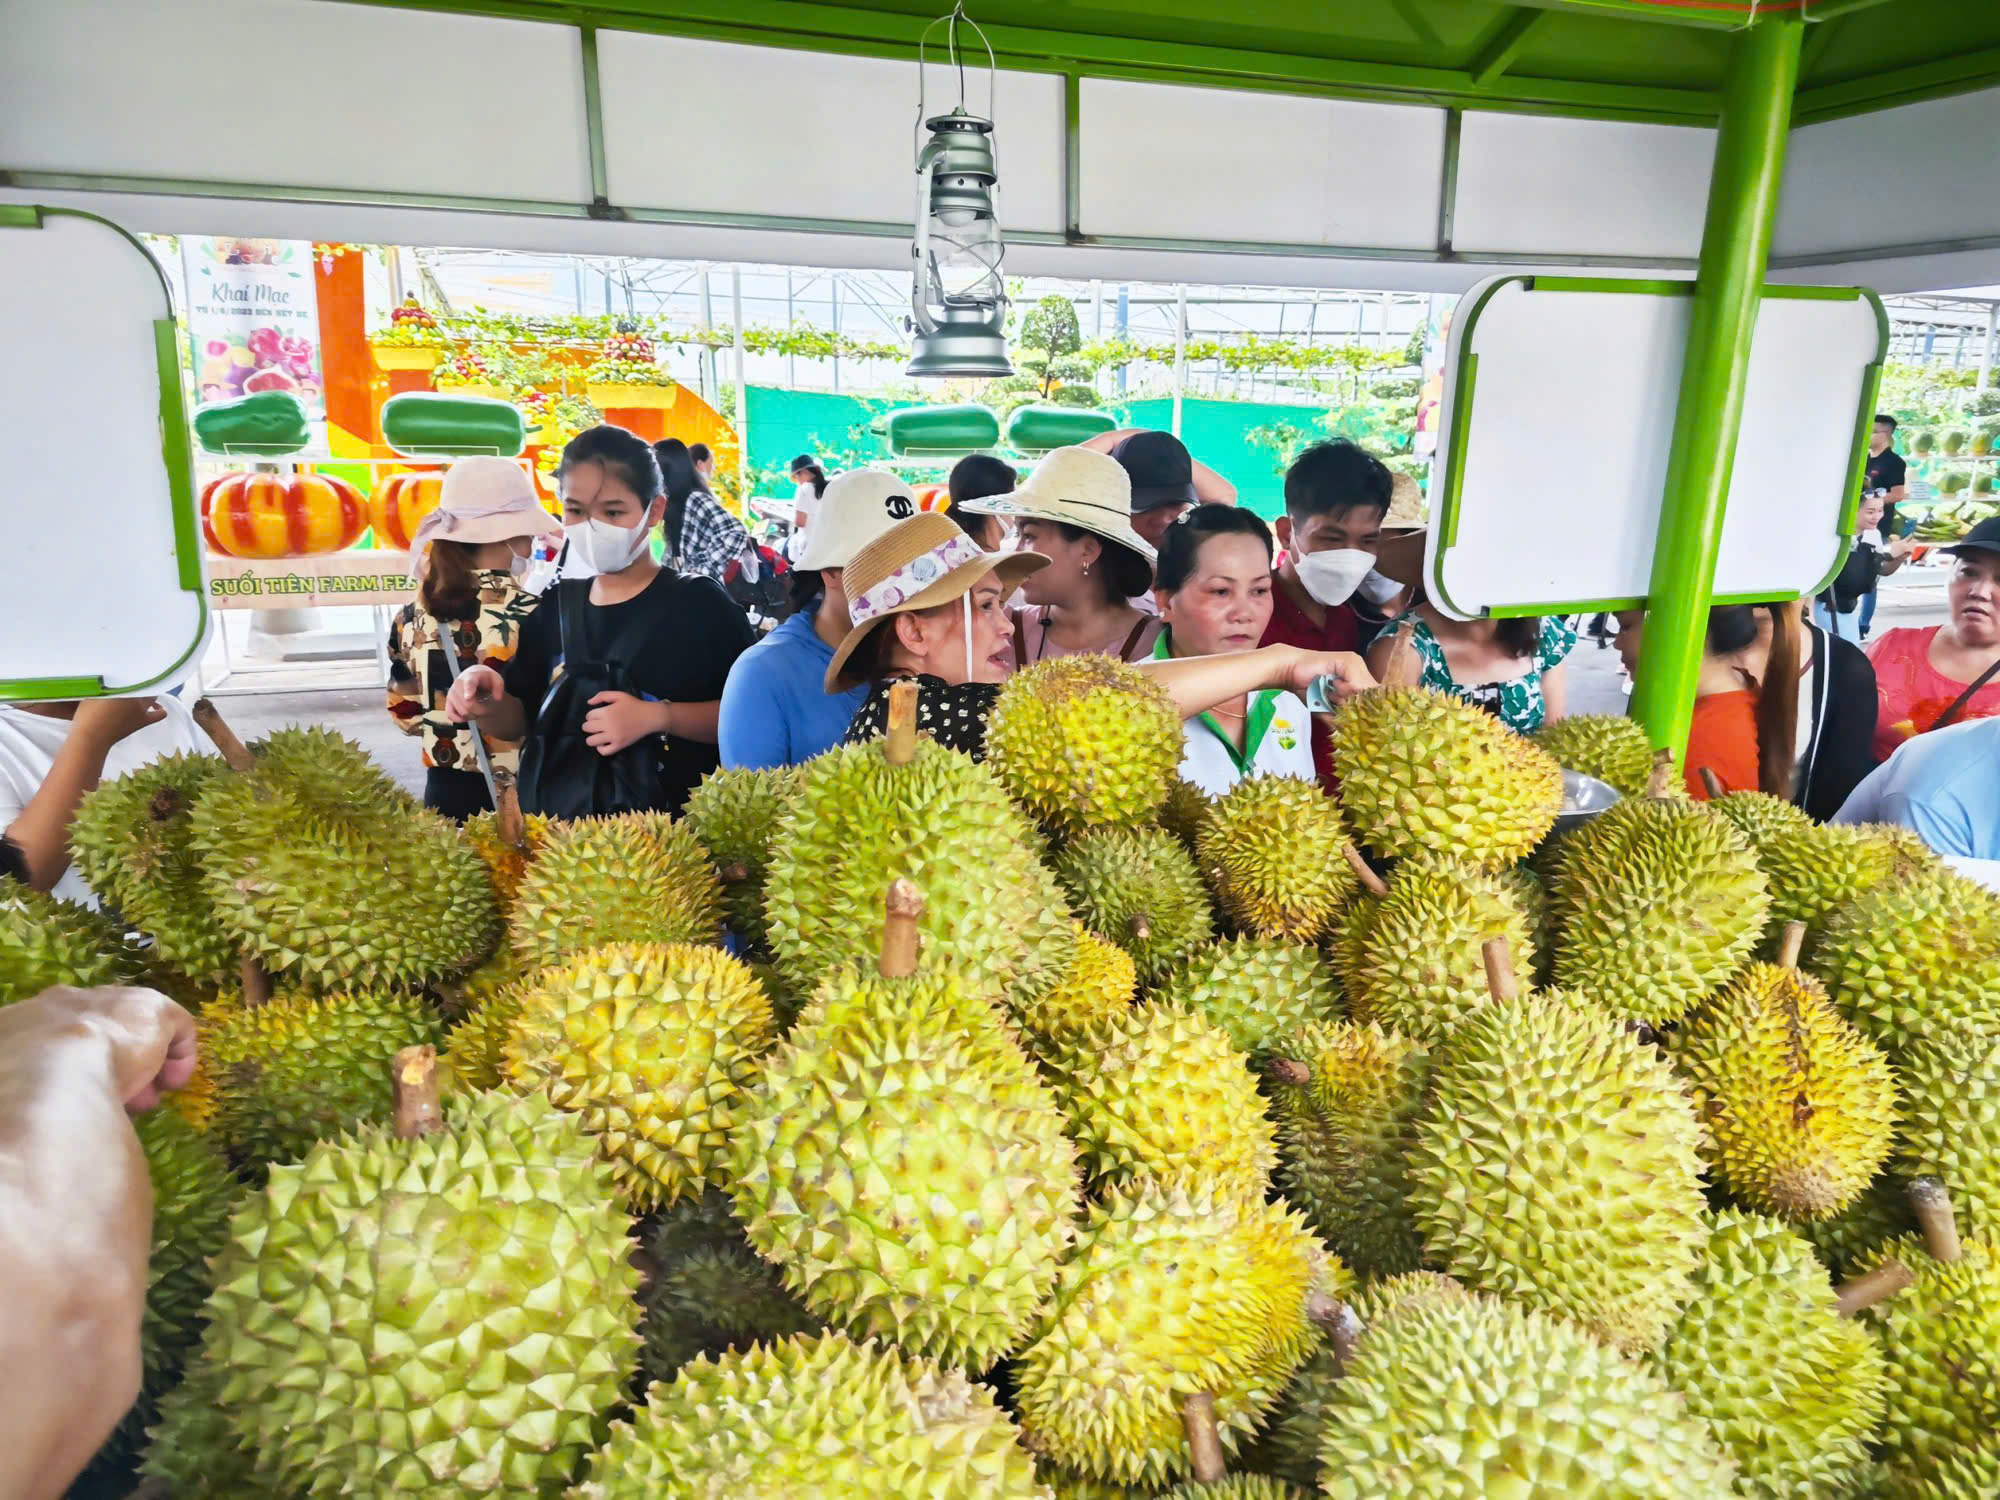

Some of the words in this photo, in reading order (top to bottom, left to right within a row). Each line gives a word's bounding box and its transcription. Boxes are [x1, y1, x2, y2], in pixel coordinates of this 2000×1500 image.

[210, 569, 263, 596] SUỐI
[265, 573, 315, 594] TIÊN
[318, 575, 379, 593] FARM
